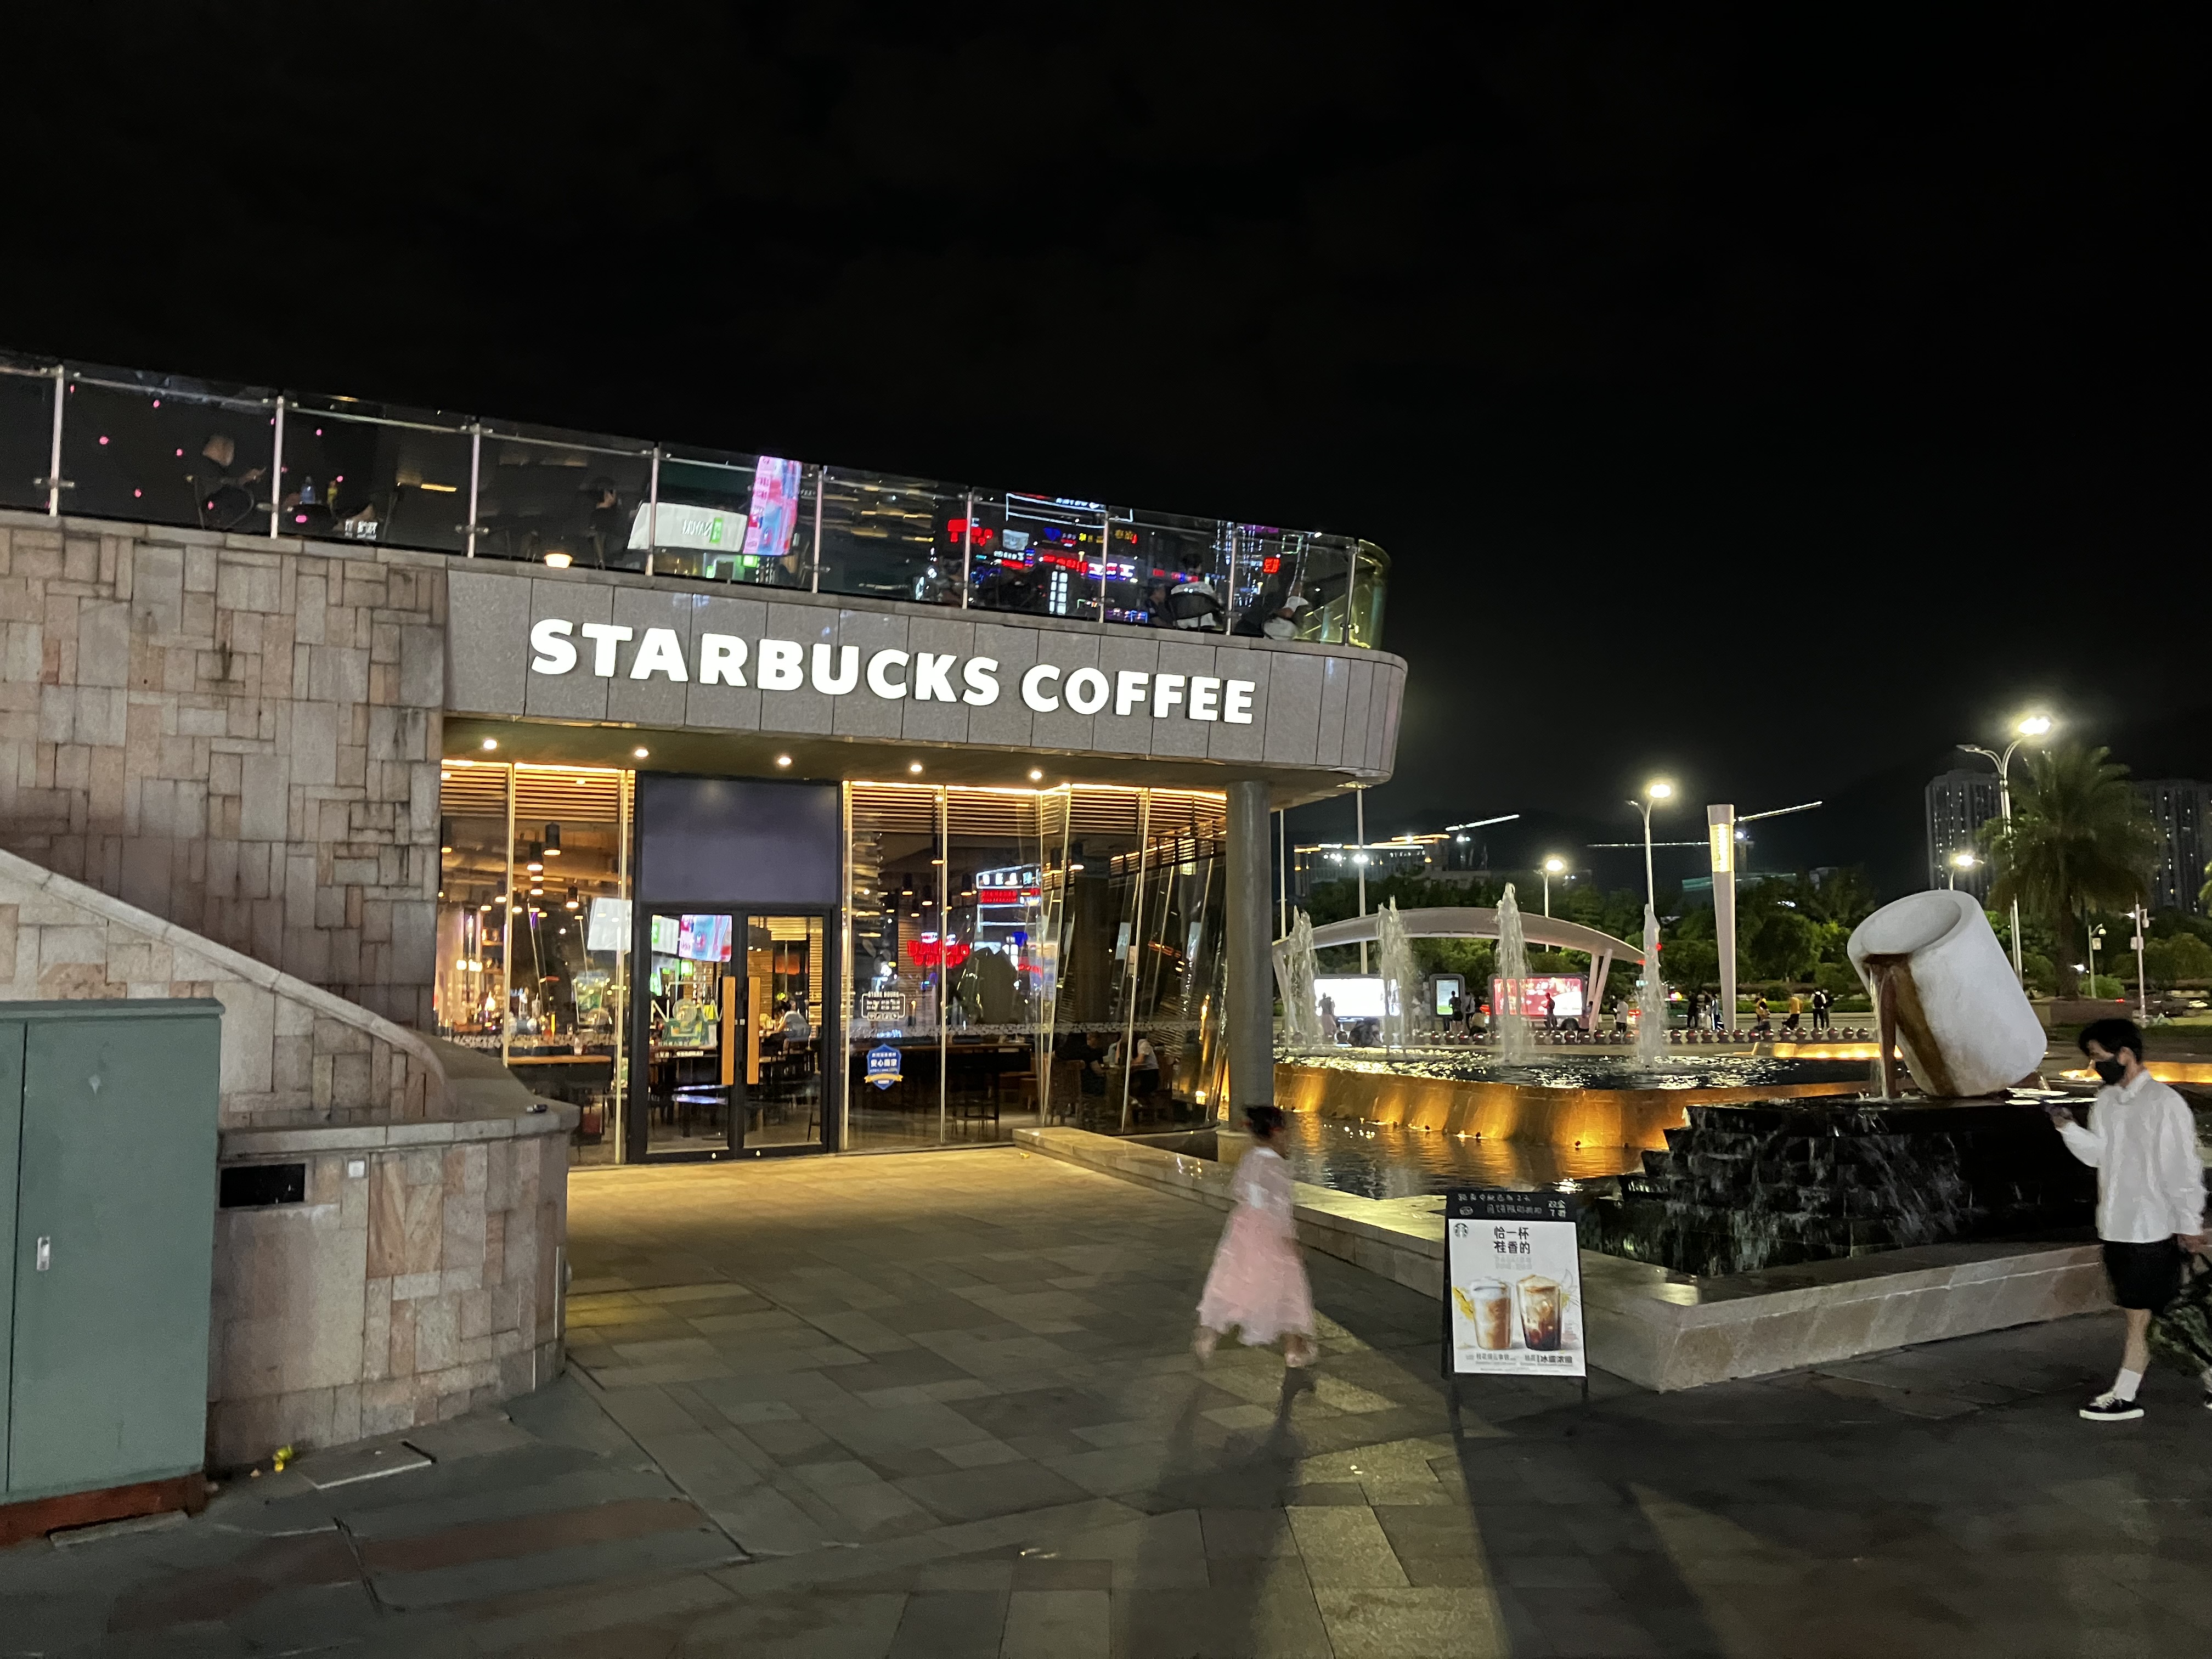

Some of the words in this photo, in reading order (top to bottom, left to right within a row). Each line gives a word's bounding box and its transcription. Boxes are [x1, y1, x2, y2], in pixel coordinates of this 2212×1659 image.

[530, 618, 1000, 706] STARBUCKS
[1022, 664, 1255, 724] COFFEE
[1493, 1240, 1531, 1254] 桂香的
